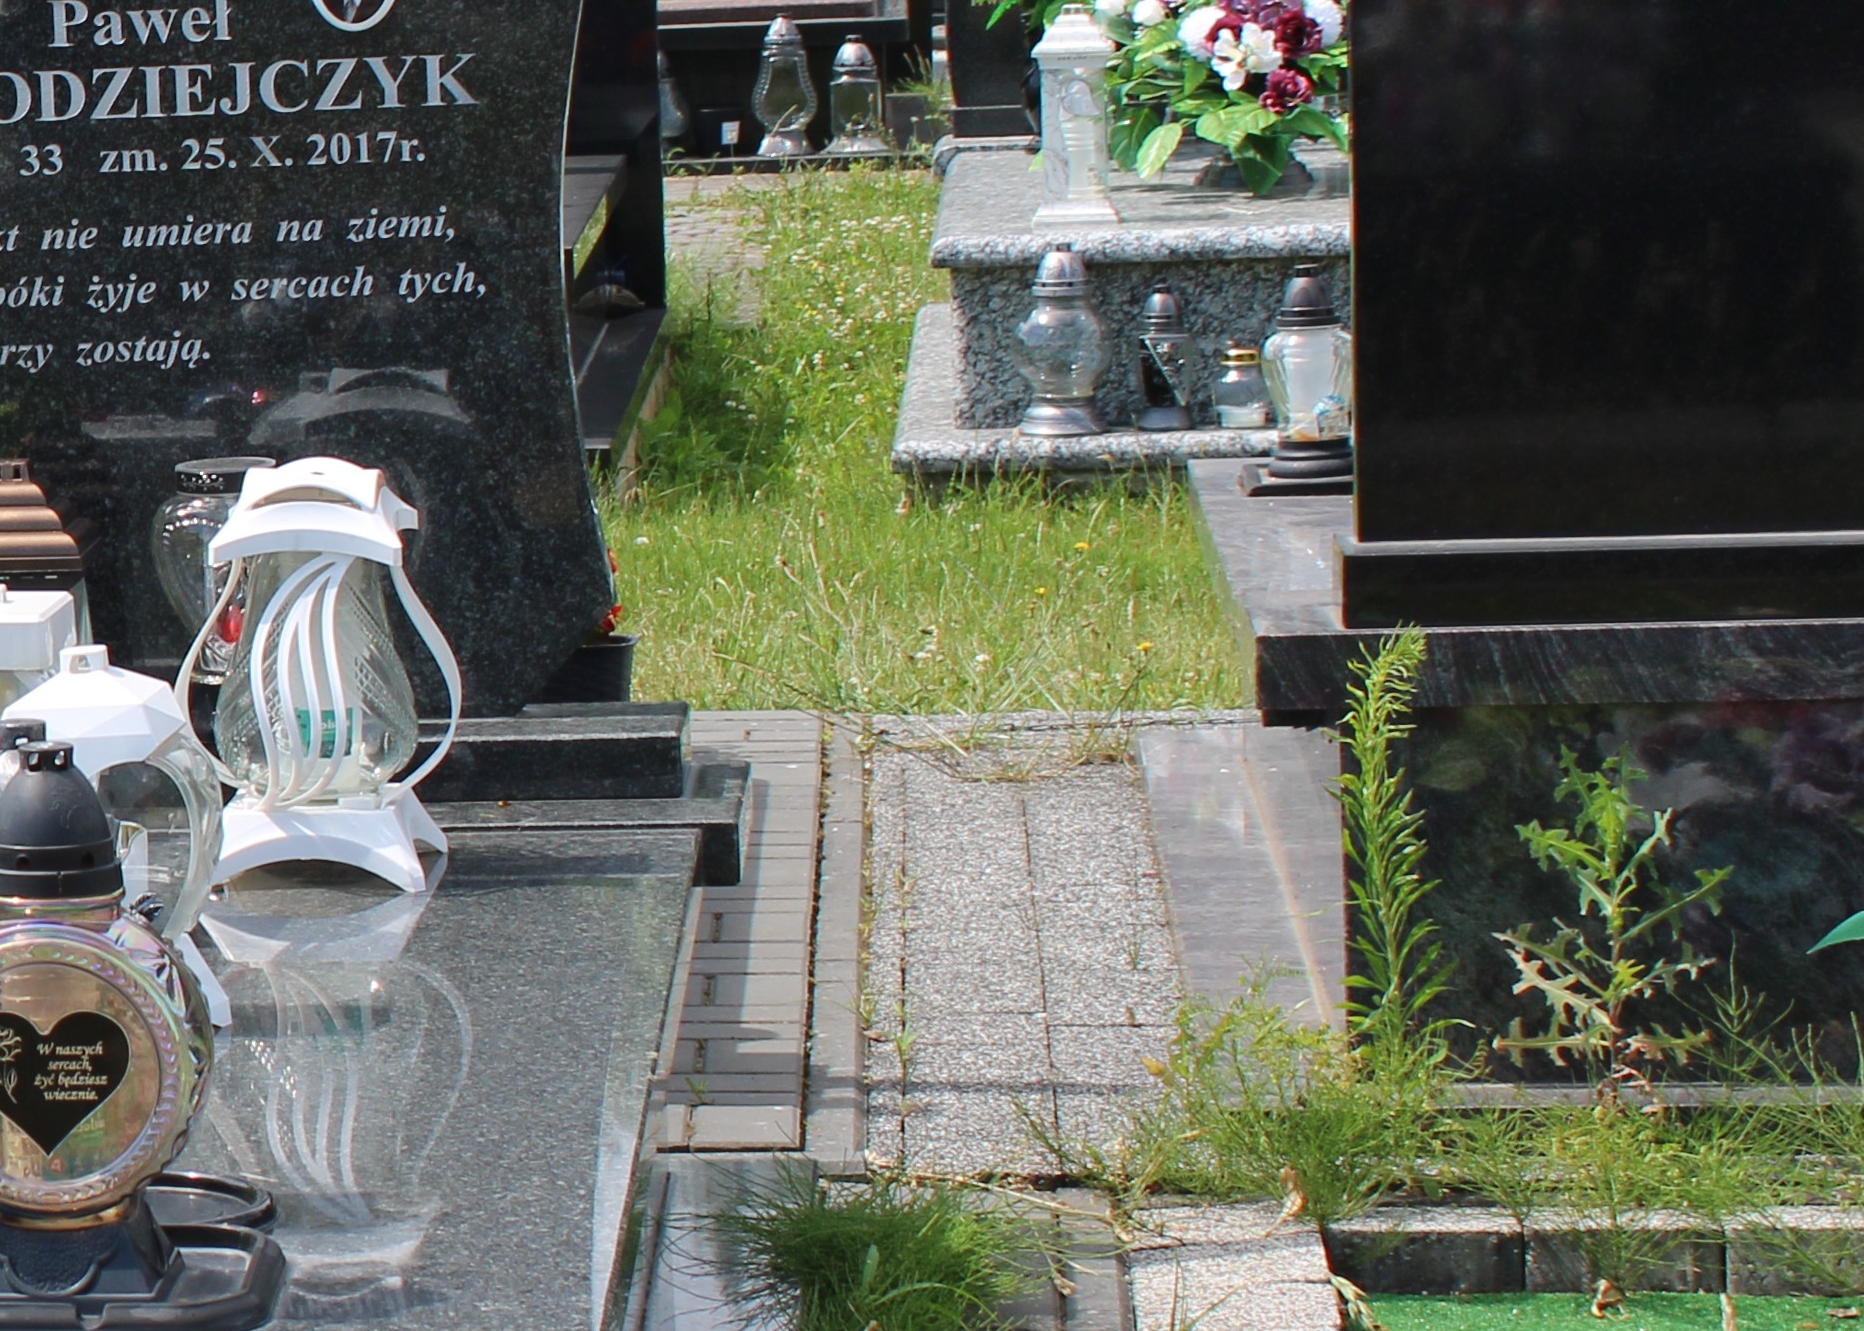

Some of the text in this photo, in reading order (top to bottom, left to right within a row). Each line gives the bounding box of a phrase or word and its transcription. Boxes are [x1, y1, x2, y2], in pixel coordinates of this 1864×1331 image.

[20, 144, 62, 176] 33
[100, 150, 167, 172] zm.
[182, 138, 236, 169] 25.
[251, 136, 293, 166] X.
[307, 131, 425, 165] 2017r.
[41, 221, 97, 249] nie
[123, 218, 252, 247] umiera
[277, 220, 322, 241] na
[348, 206, 454, 242] ziemi,
[88, 278, 156, 313] żyje
[181, 280, 209, 301] w
[231, 266, 373, 300] sercach
[399, 262, 485, 300] tych,
[77, 330, 210, 369] zostają.
[37, 1041, 103, 1059] W naszych
[47, 1057, 92, 1071] sercach,
[34, 1072, 108, 1089] żyć będziesz
[43, 1088, 98, 1100] wiecznie.
